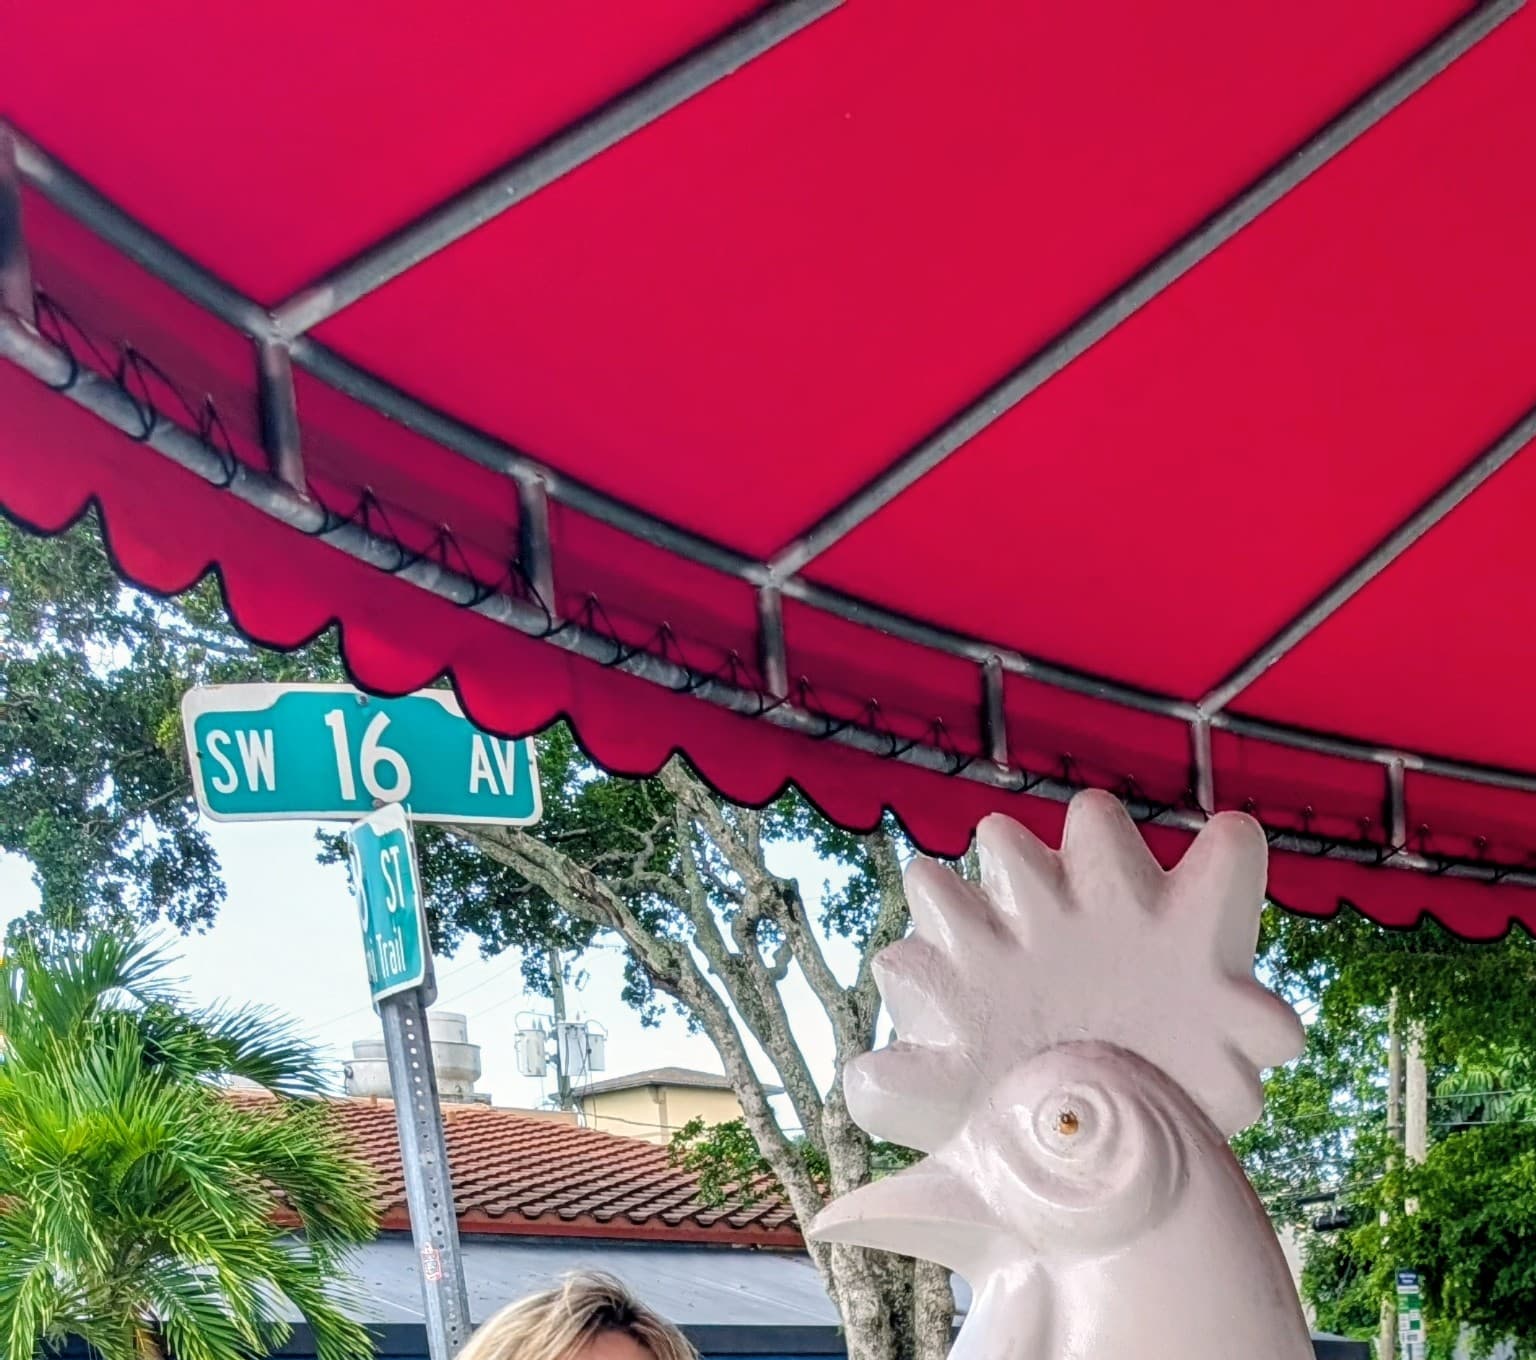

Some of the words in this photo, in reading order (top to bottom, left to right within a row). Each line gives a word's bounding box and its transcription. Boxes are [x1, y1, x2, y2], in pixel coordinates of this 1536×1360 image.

[205, 728, 276, 795] SW
[324, 708, 411, 803] 16
[468, 733, 516, 796] AV
[380, 845, 405, 914] ST
[375, 926, 407, 979] Trail
